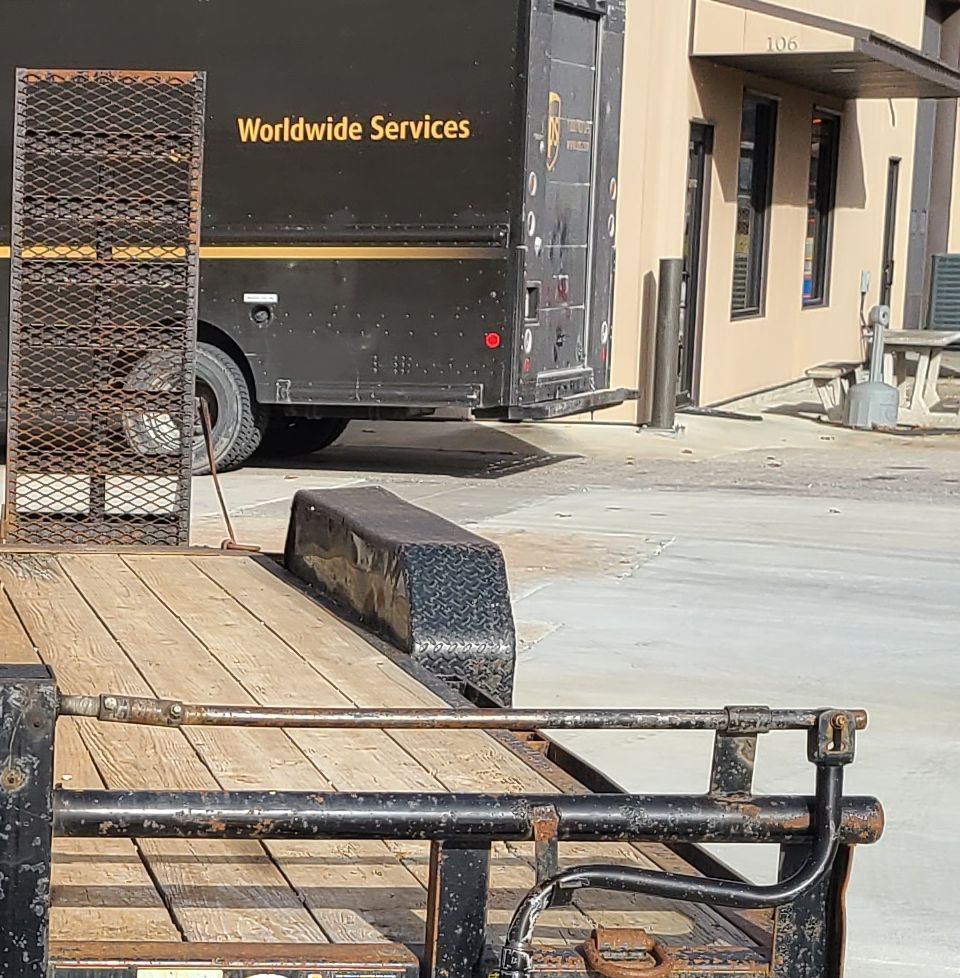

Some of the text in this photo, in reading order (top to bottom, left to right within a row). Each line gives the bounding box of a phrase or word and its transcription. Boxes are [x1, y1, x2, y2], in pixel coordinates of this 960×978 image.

[767, 35, 798, 52] 106
[238, 114, 471, 142] Worldwide Services
